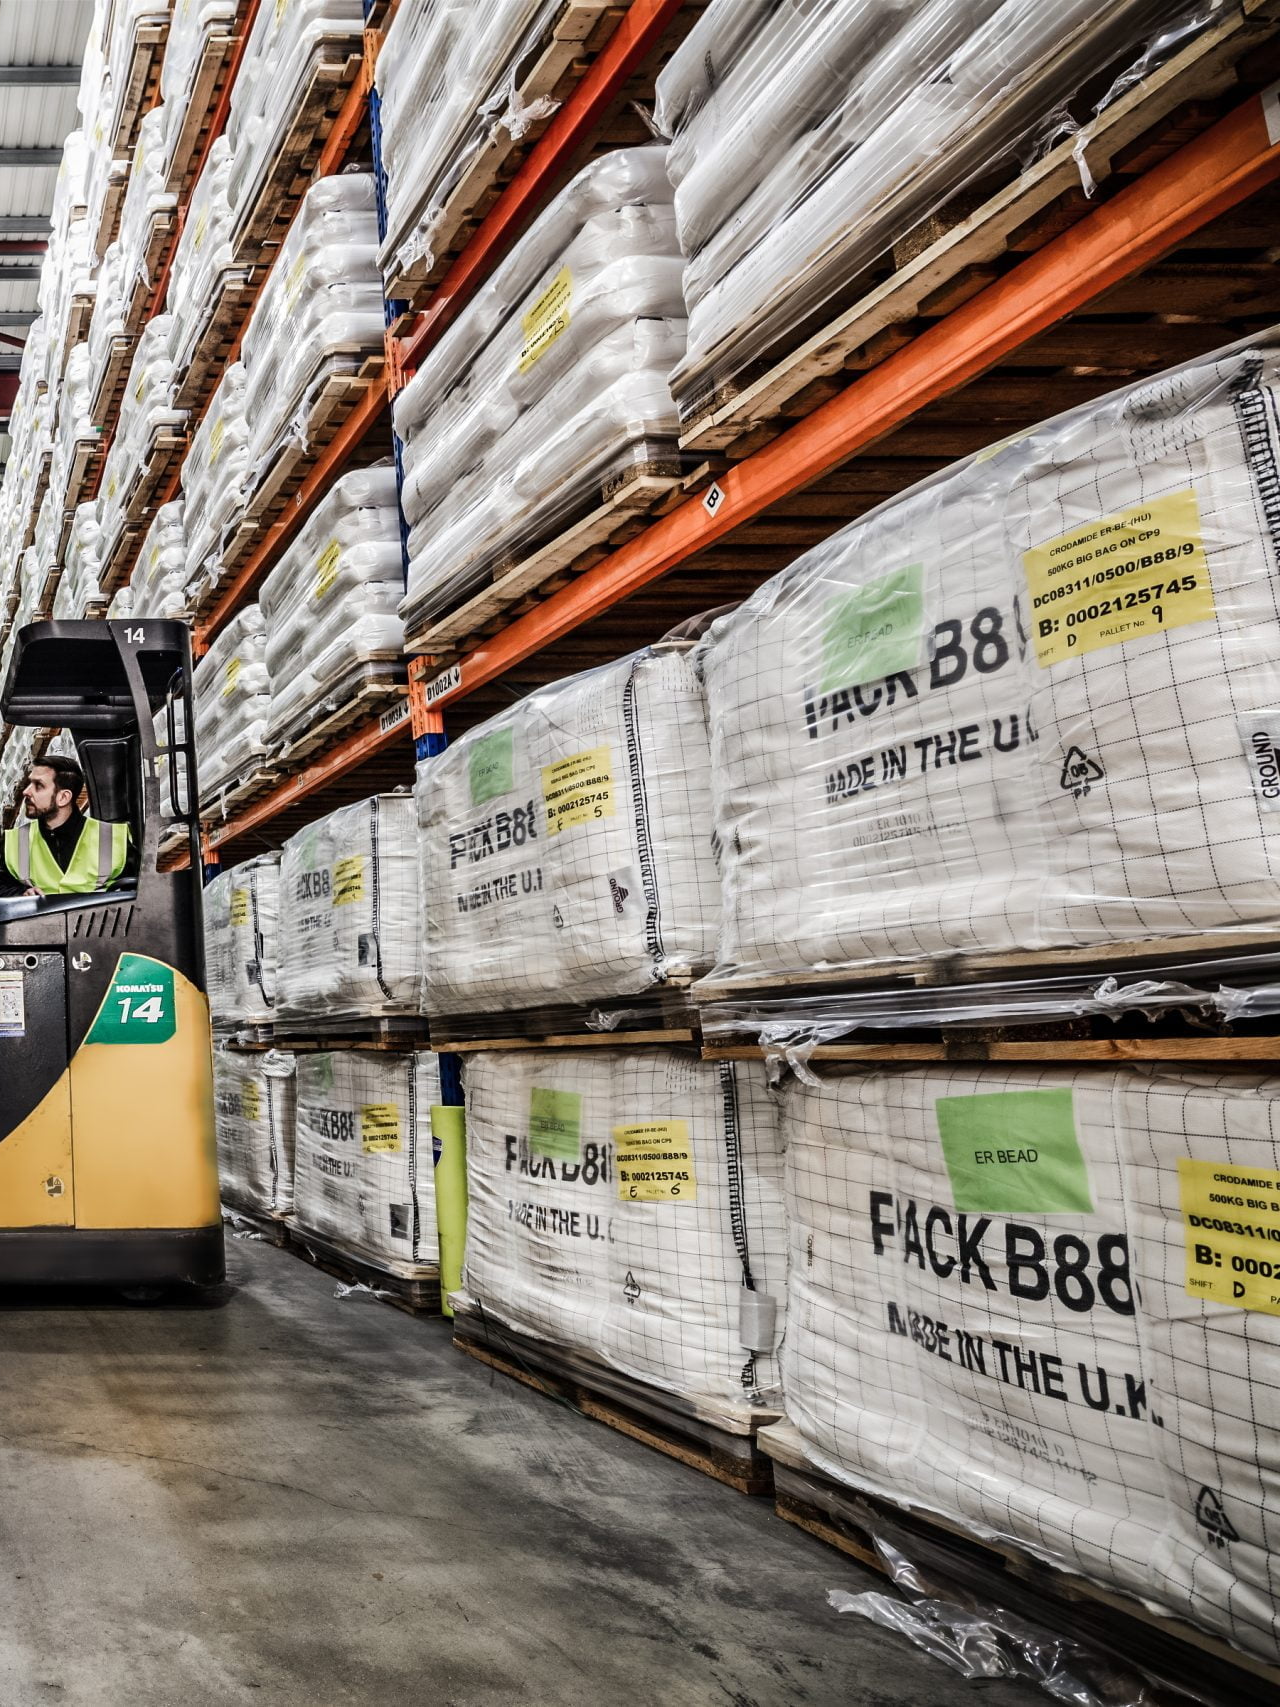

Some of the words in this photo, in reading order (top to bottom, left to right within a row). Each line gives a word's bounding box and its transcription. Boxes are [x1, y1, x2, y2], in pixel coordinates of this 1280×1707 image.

[707, 488, 719, 508] B
[1049, 532, 1098, 557] CRODAMIDE
[1099, 511, 1153, 538] ER-BE-(HU)
[1047, 558, 1075, 577] 500KG
[1076, 551, 1095, 568] BIG
[1095, 543, 1119, 561] BAG
[1119, 536, 1138, 553] ON
[1137, 528, 1161, 547] CP9
[1033, 542, 1195, 608] DC08311/0500/B88/9
[1038, 617, 1060, 638] B:
[1066, 574, 1198, 628] 0002125745
[1151, 605, 1163, 624] 9
[123, 627, 146, 645] 14
[930, 594, 1027, 691] B8
[1067, 633, 1077, 648] D
[1100, 622, 1131, 639] PALLET
[427, 673, 453, 701] D1002A
[825, 756, 878, 805] MADE
[882, 744, 908, 781] IN
[914, 724, 983, 773] THE
[1252, 731, 1280, 799] GROUND
[547, 807, 556, 819] B:
[558, 791, 609, 814] 0002125745
[1073, 785, 1092, 799] PP
[594, 805, 603, 818] 5
[493, 874, 517, 902] THE
[610, 878, 624, 914] GROUND
[115, 983, 164, 993] KOMATSU
[117, 996, 165, 1024] 14
[974, 1150, 995, 1165] ER
[997, 1147, 1039, 1163] BEAD
[620, 1170, 630, 1182] B:
[631, 1171, 689, 1182] 0002125745
[670, 1182, 681, 1195] 6
[1213, 1173, 1273, 1190] CRODAMIDE
[1209, 1193, 1244, 1207] 500KG
[1247, 1199, 1268, 1210] BIG
[535, 1205, 547, 1232] IN
[550, 1207, 582, 1238] THE
[1194, 1243, 1223, 1268] B:
[1005, 1222, 1143, 1317] B88
[1233, 1280, 1246, 1299] D
[955, 1329, 987, 1376] IN
[992, 1340, 1069, 1402] THE
